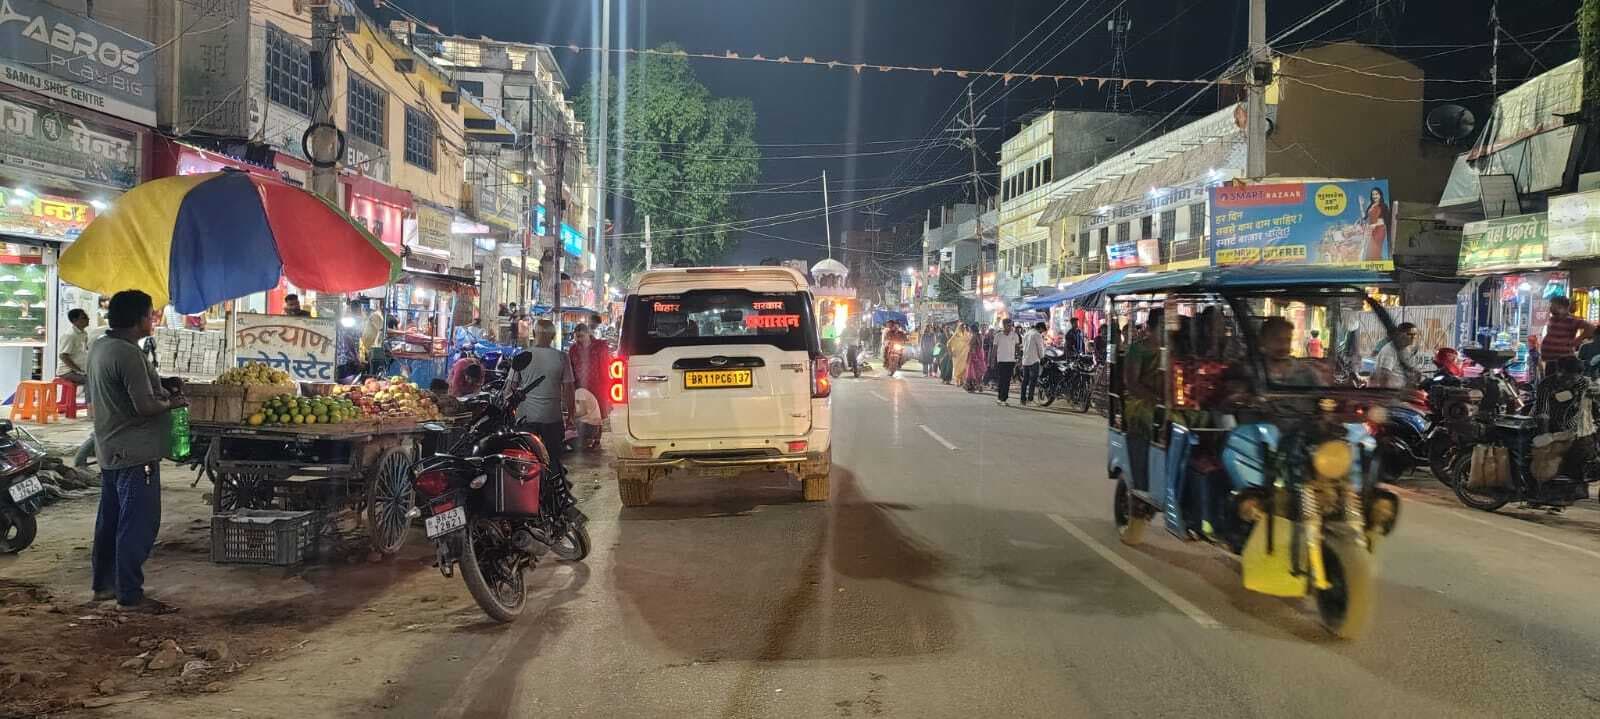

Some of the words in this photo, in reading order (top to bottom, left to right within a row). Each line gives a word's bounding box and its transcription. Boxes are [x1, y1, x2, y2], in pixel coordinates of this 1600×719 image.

[22, 15, 140, 75] ABROS
[5, 66, 41, 88] SAMAJ
[44, 80, 69, 97] SHOE
[71, 87, 104, 107] CENTRE
[112, 76, 143, 97] BIG
[347, 146, 370, 172] EURO
[1231, 190, 1264, 201] SMART
[1265, 191, 1301, 199] BAZAAR
[1215, 215, 1225, 224] हर
[1228, 210, 1243, 222] दिन
[1279, 247, 1305, 256] FREE
[653, 302, 681, 313] बिहार
[752, 301, 784, 310] सरकार
[236, 319, 333, 349] कल्याण
[293, 347, 334, 374] स्टेट
[691, 373, 750, 385] BR11PC6137
